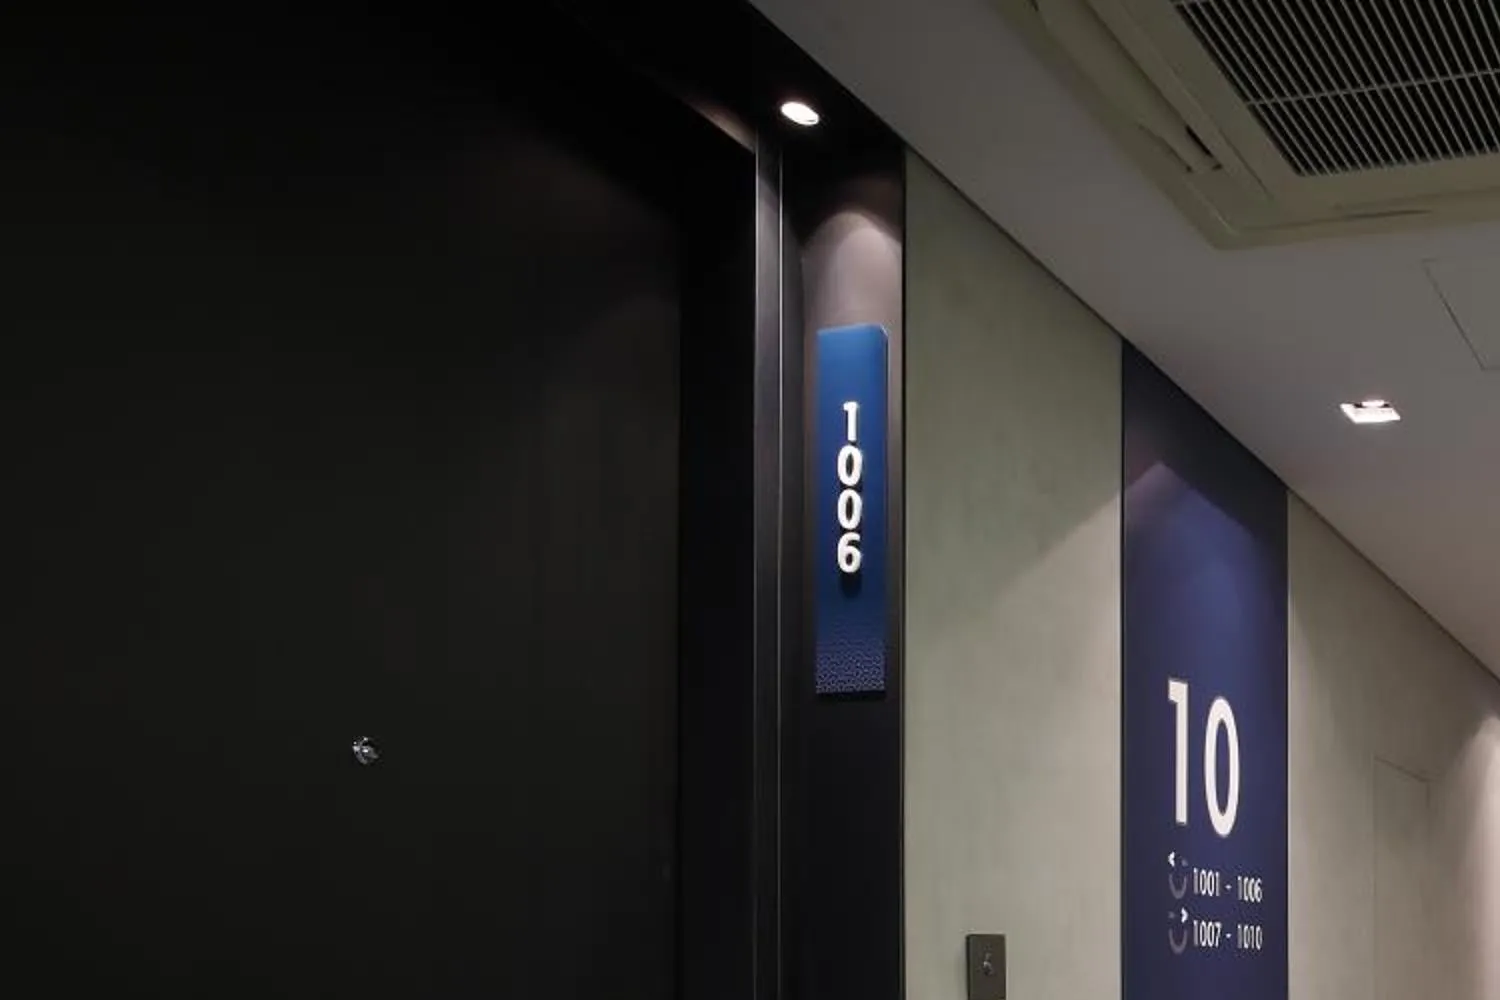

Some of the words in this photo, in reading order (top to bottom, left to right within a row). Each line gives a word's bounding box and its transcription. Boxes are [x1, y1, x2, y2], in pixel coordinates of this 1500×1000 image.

[836, 401, 863, 573] 1006
[1167, 679, 1240, 838] 10
[1193, 867, 1220, 896] 1001
[1237, 875, 1263, 902] 1006
[1193, 919, 1222, 947] 1007
[1237, 923, 1263, 950] 1010
